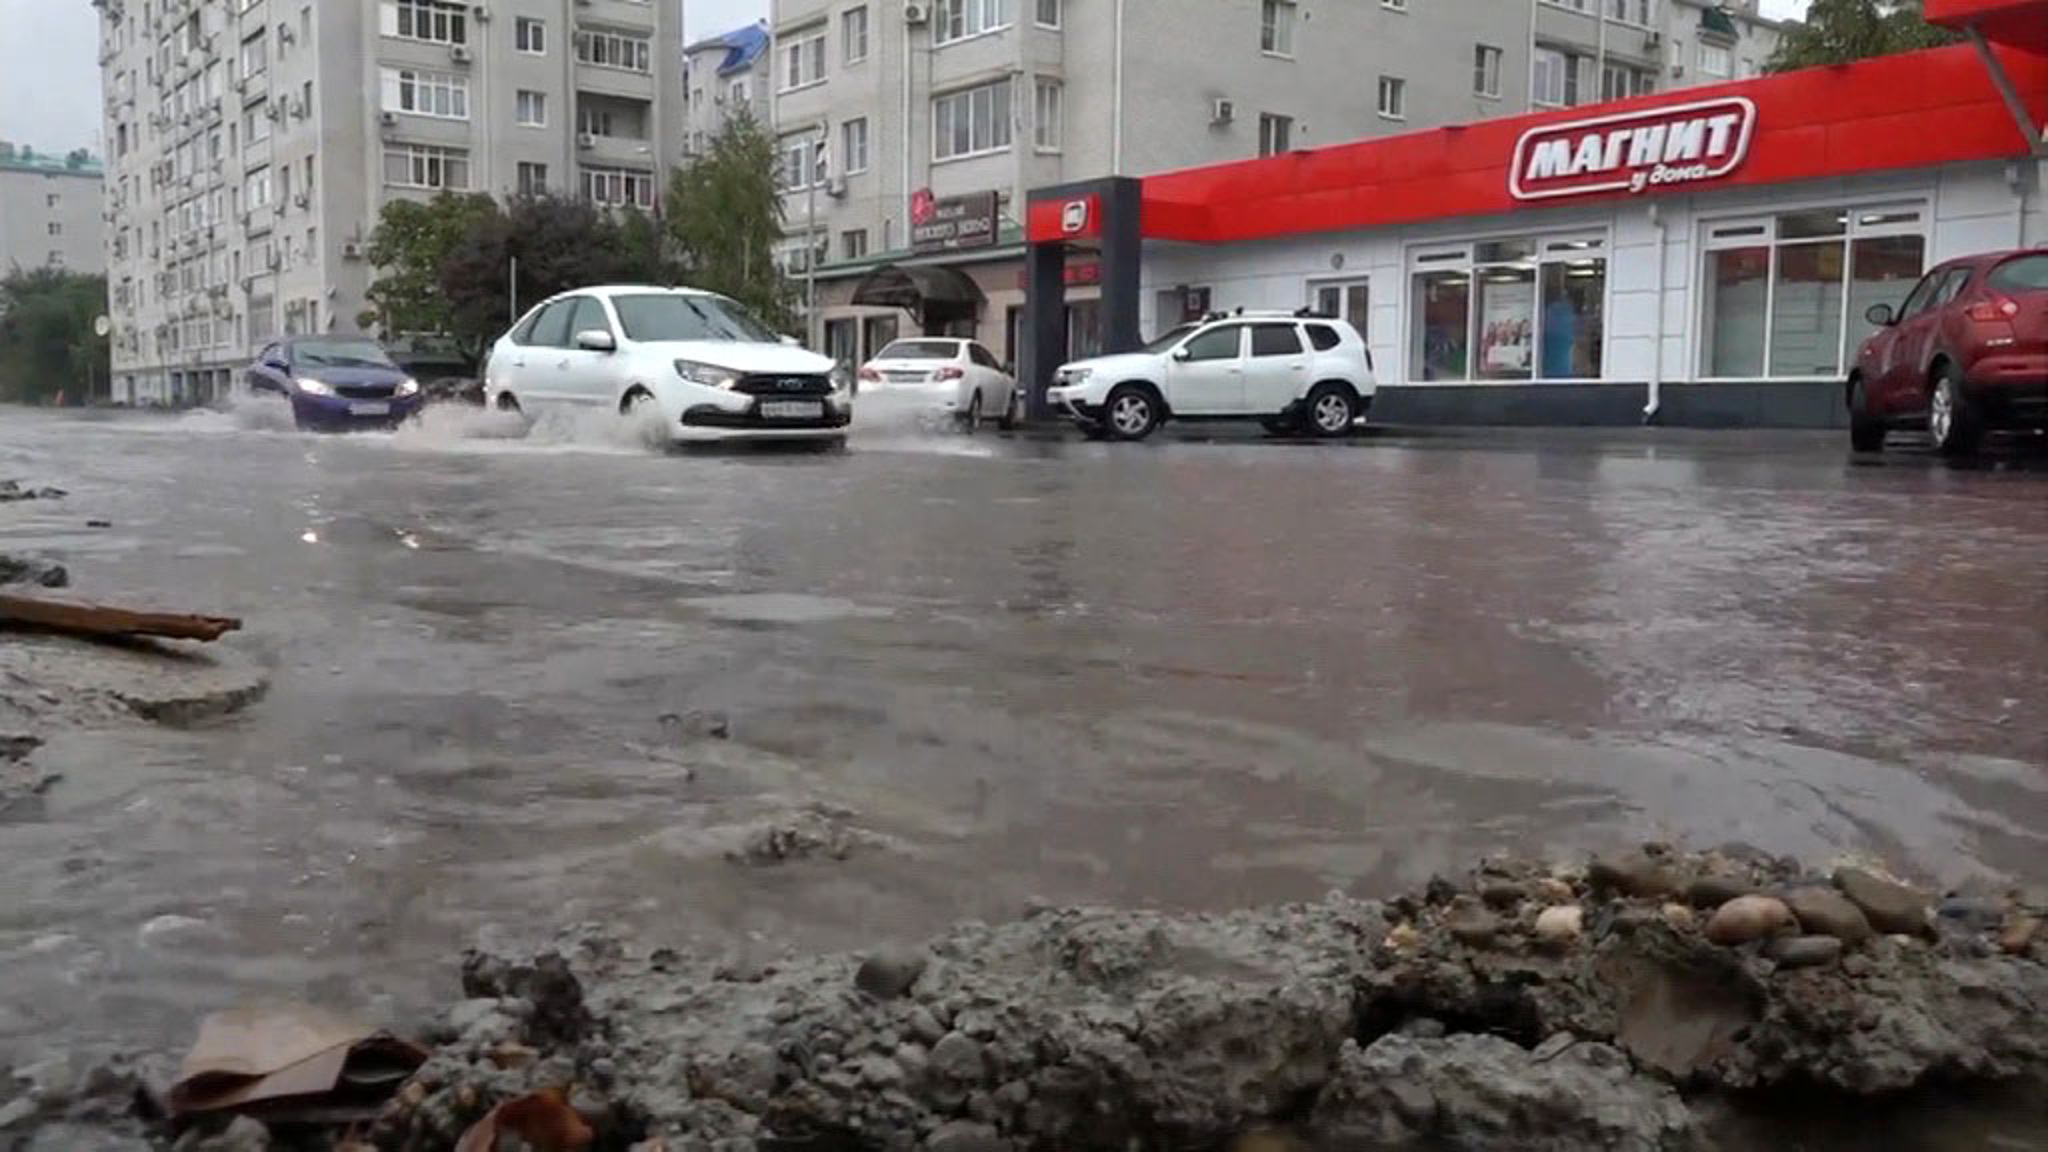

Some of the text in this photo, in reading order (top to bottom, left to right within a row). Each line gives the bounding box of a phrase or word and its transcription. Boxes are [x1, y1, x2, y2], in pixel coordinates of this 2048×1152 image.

[1525, 114, 1739, 180] МАГНИТ
[1629, 164, 1706, 193] у дома
